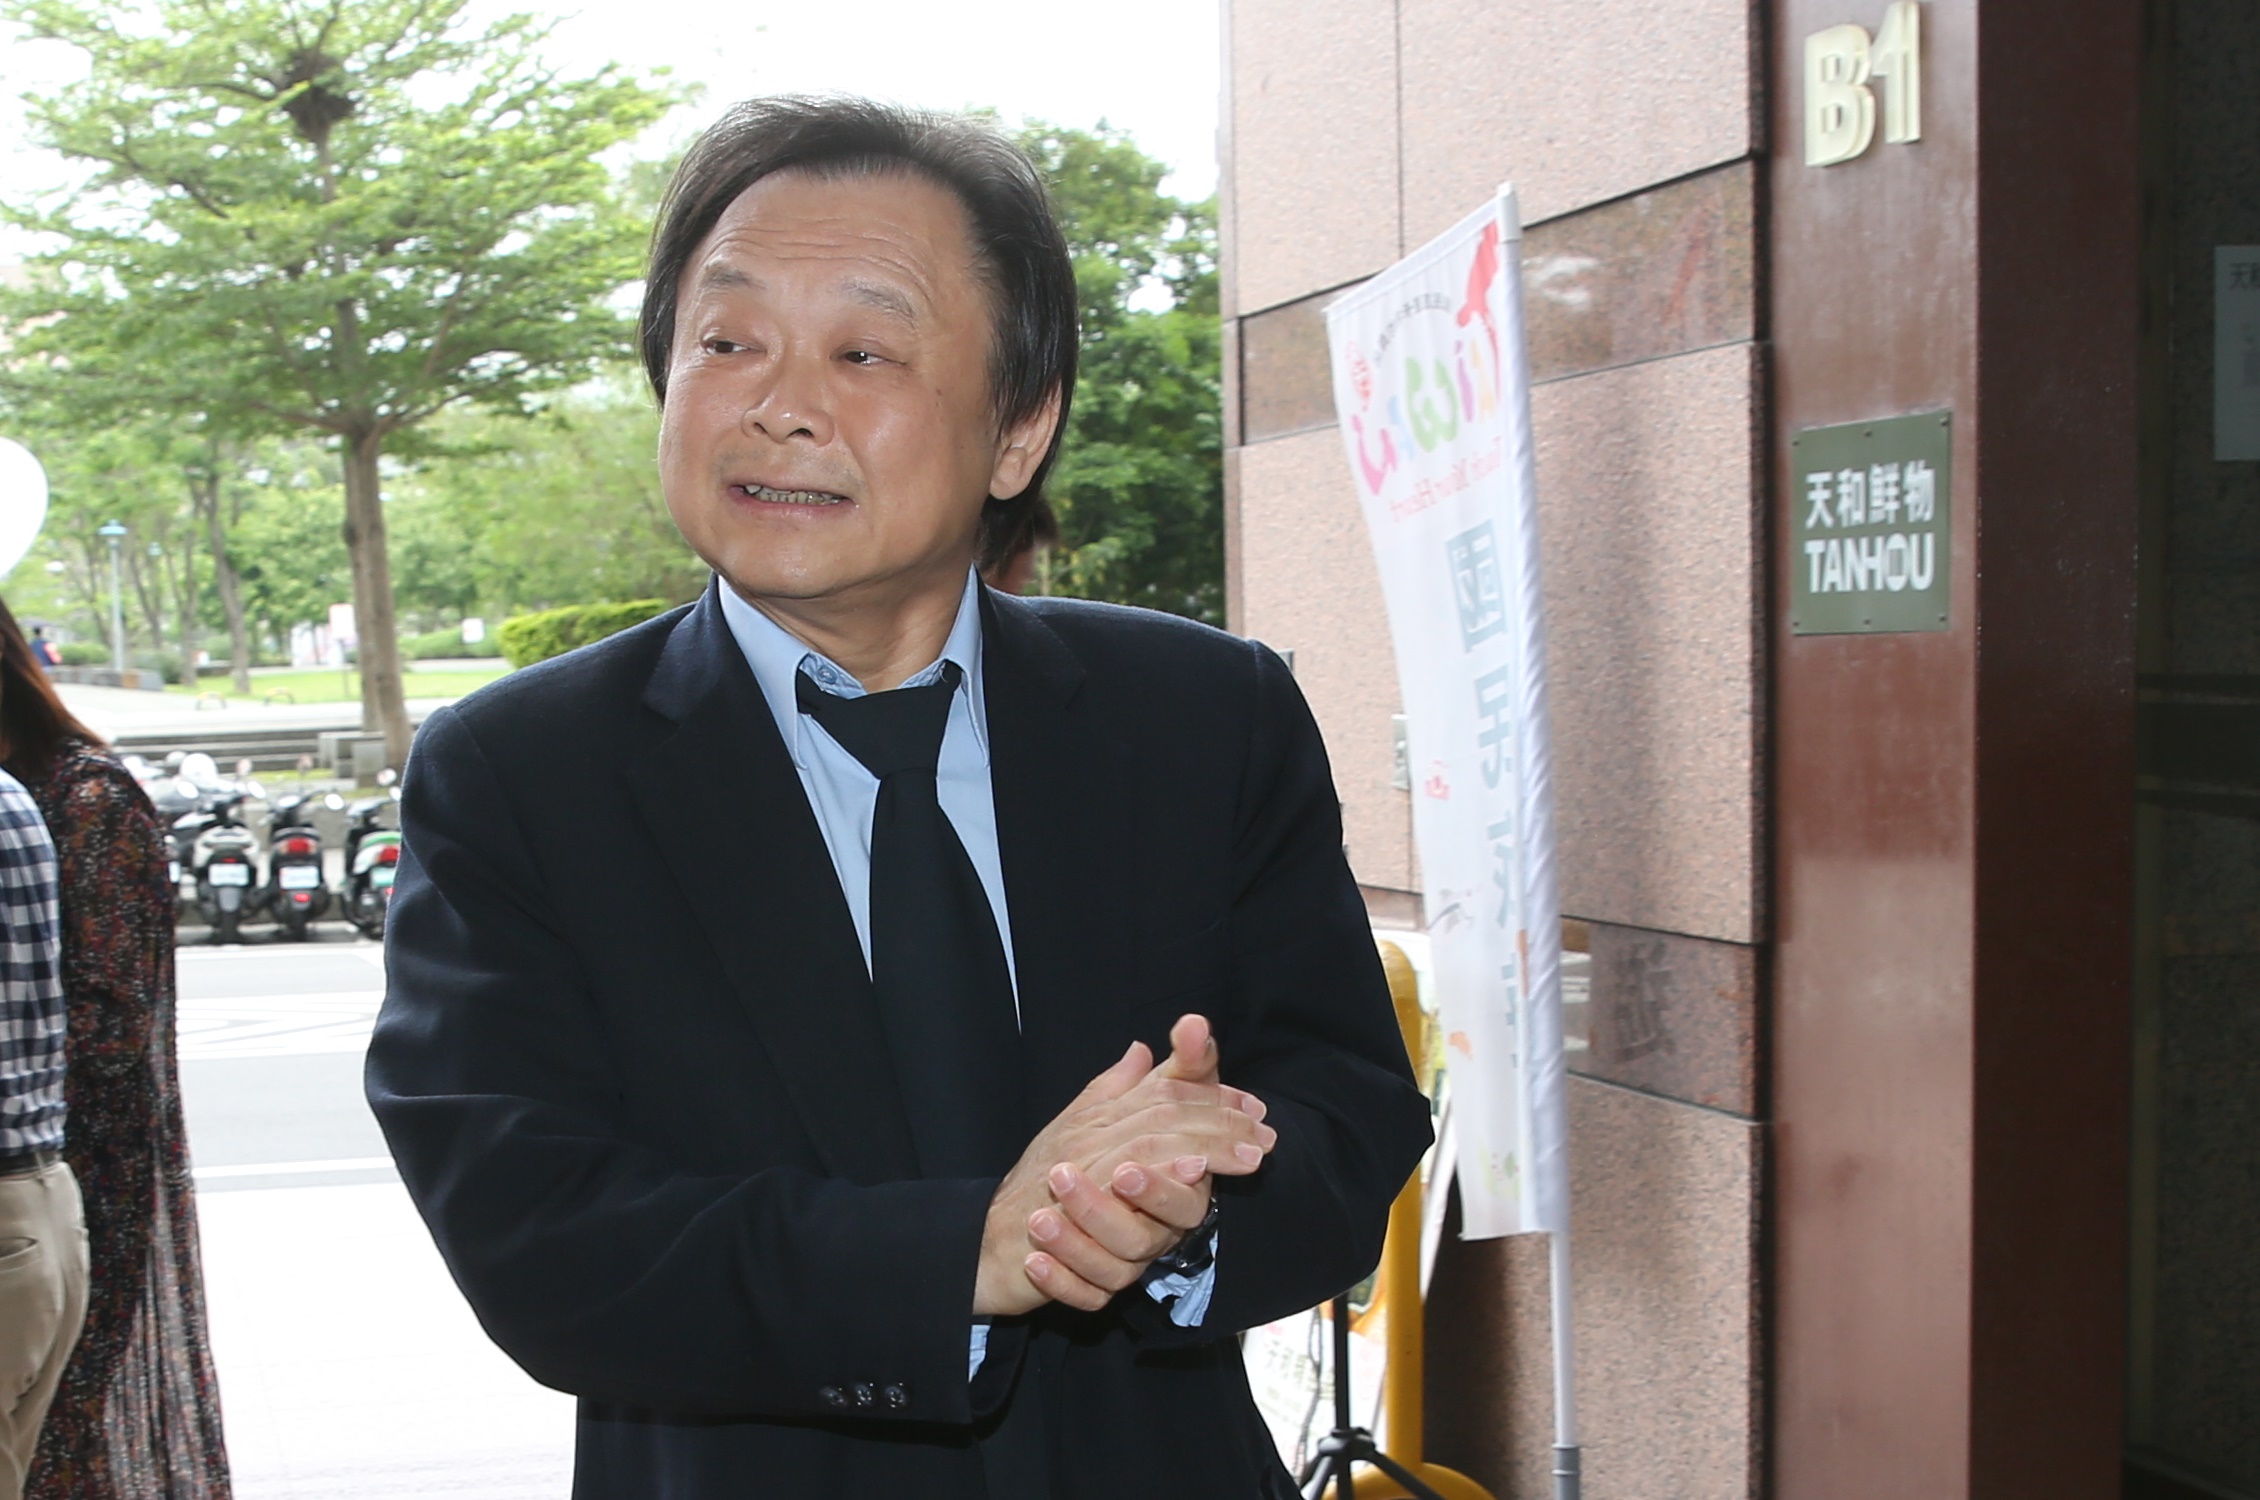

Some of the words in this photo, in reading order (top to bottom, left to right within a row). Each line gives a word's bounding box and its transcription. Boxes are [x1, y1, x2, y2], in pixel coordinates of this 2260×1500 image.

[1804, 1, 1921, 167] B1
[1805, 460, 1935, 529] 天和鮮物
[1804, 531, 1936, 594] TANHOU
